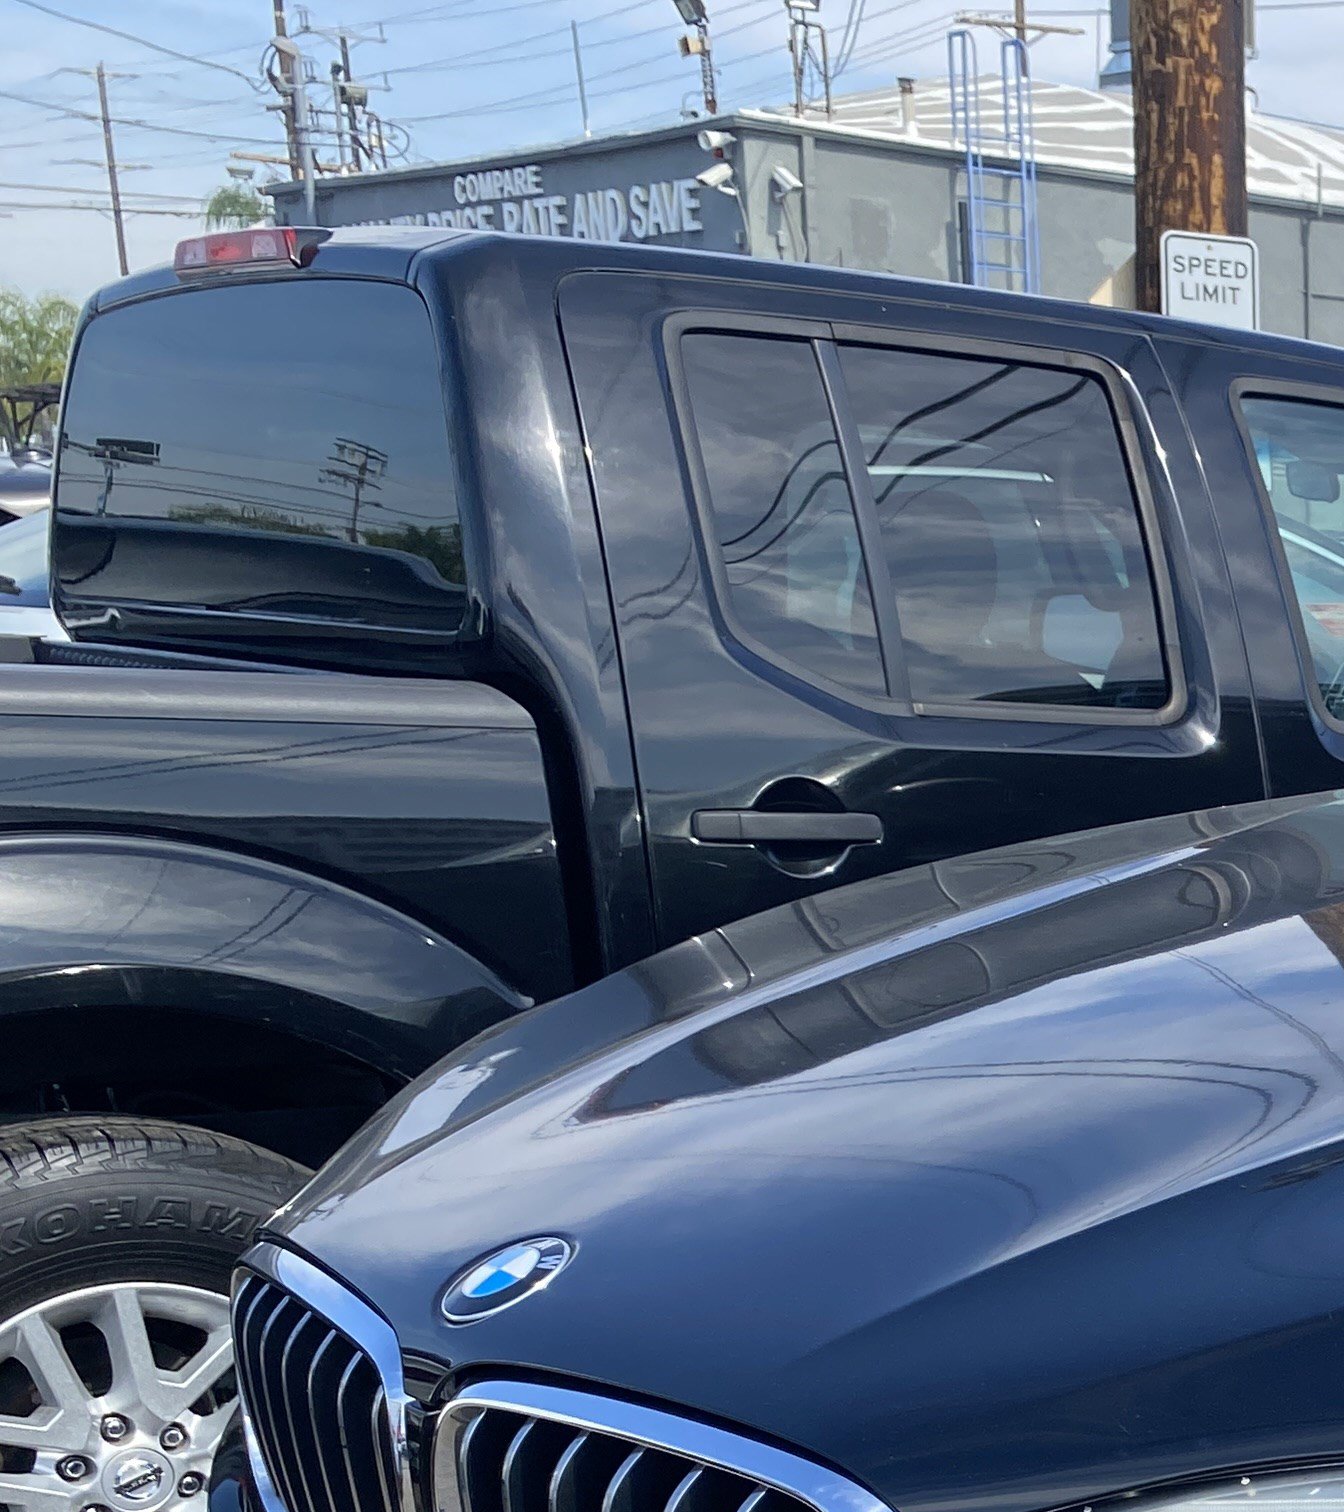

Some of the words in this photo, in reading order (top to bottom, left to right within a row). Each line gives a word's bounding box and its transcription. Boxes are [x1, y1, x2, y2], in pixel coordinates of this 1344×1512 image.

[454, 165, 544, 204] COMPARE
[573, 188, 628, 242] AND
[629, 178, 703, 238] SAVE
[1173, 255, 1248, 279] SPEED
[1181, 282, 1241, 305] LIMIT
